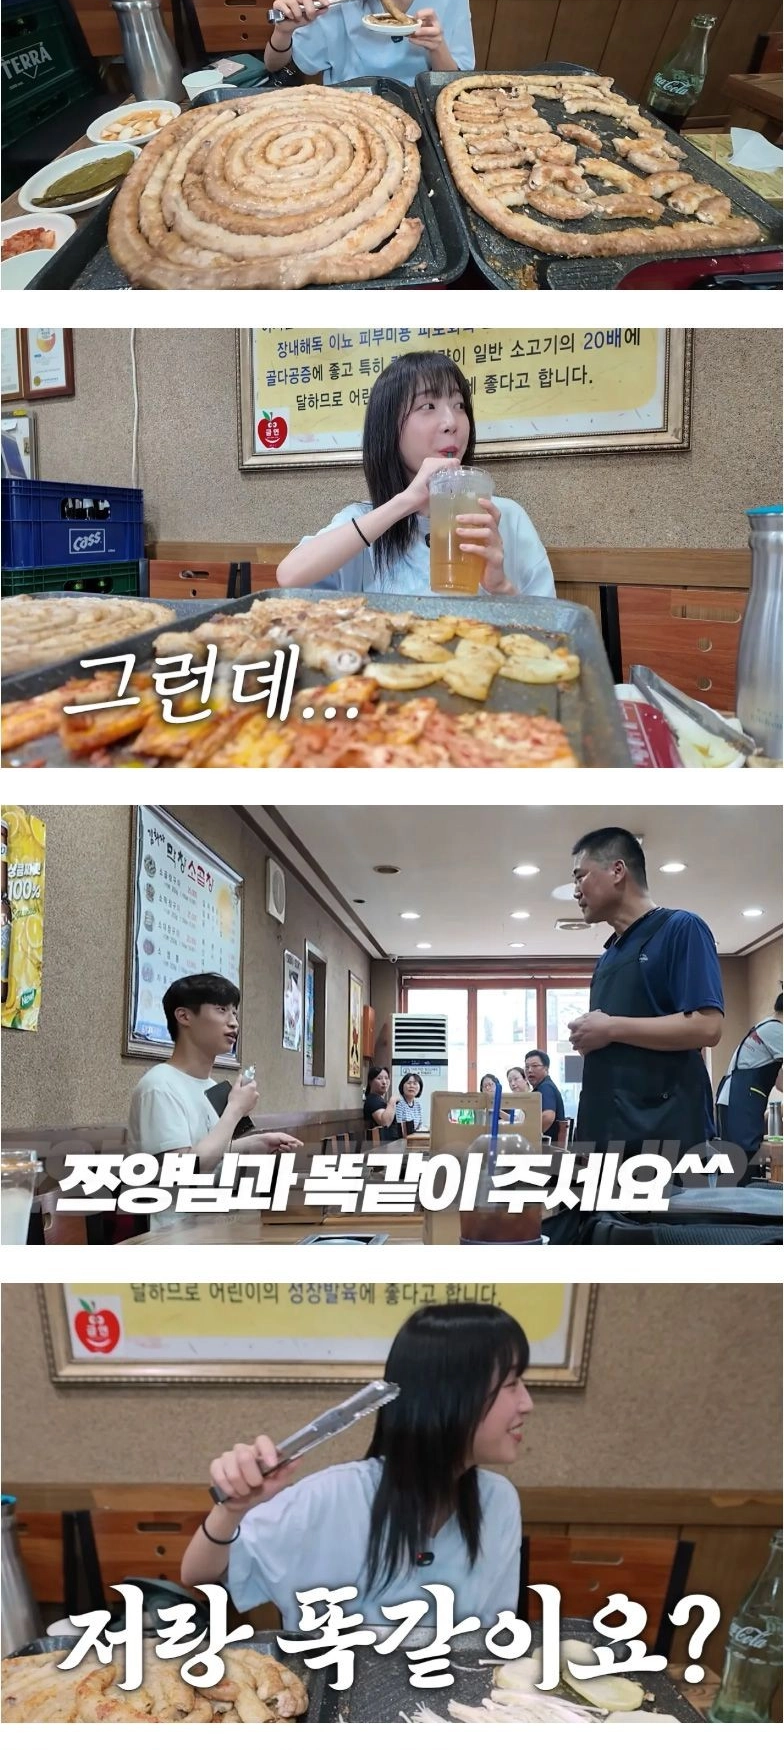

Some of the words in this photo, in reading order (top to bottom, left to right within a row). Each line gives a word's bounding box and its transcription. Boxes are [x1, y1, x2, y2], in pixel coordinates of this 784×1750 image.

[510, 333, 575, 358] 소고기의
[484, 371, 531, 395] 좋다고
[538, 365, 593, 390] 합니다.
[8, 880, 40, 900] 100%
[209, 1284, 279, 1304] 어린이의
